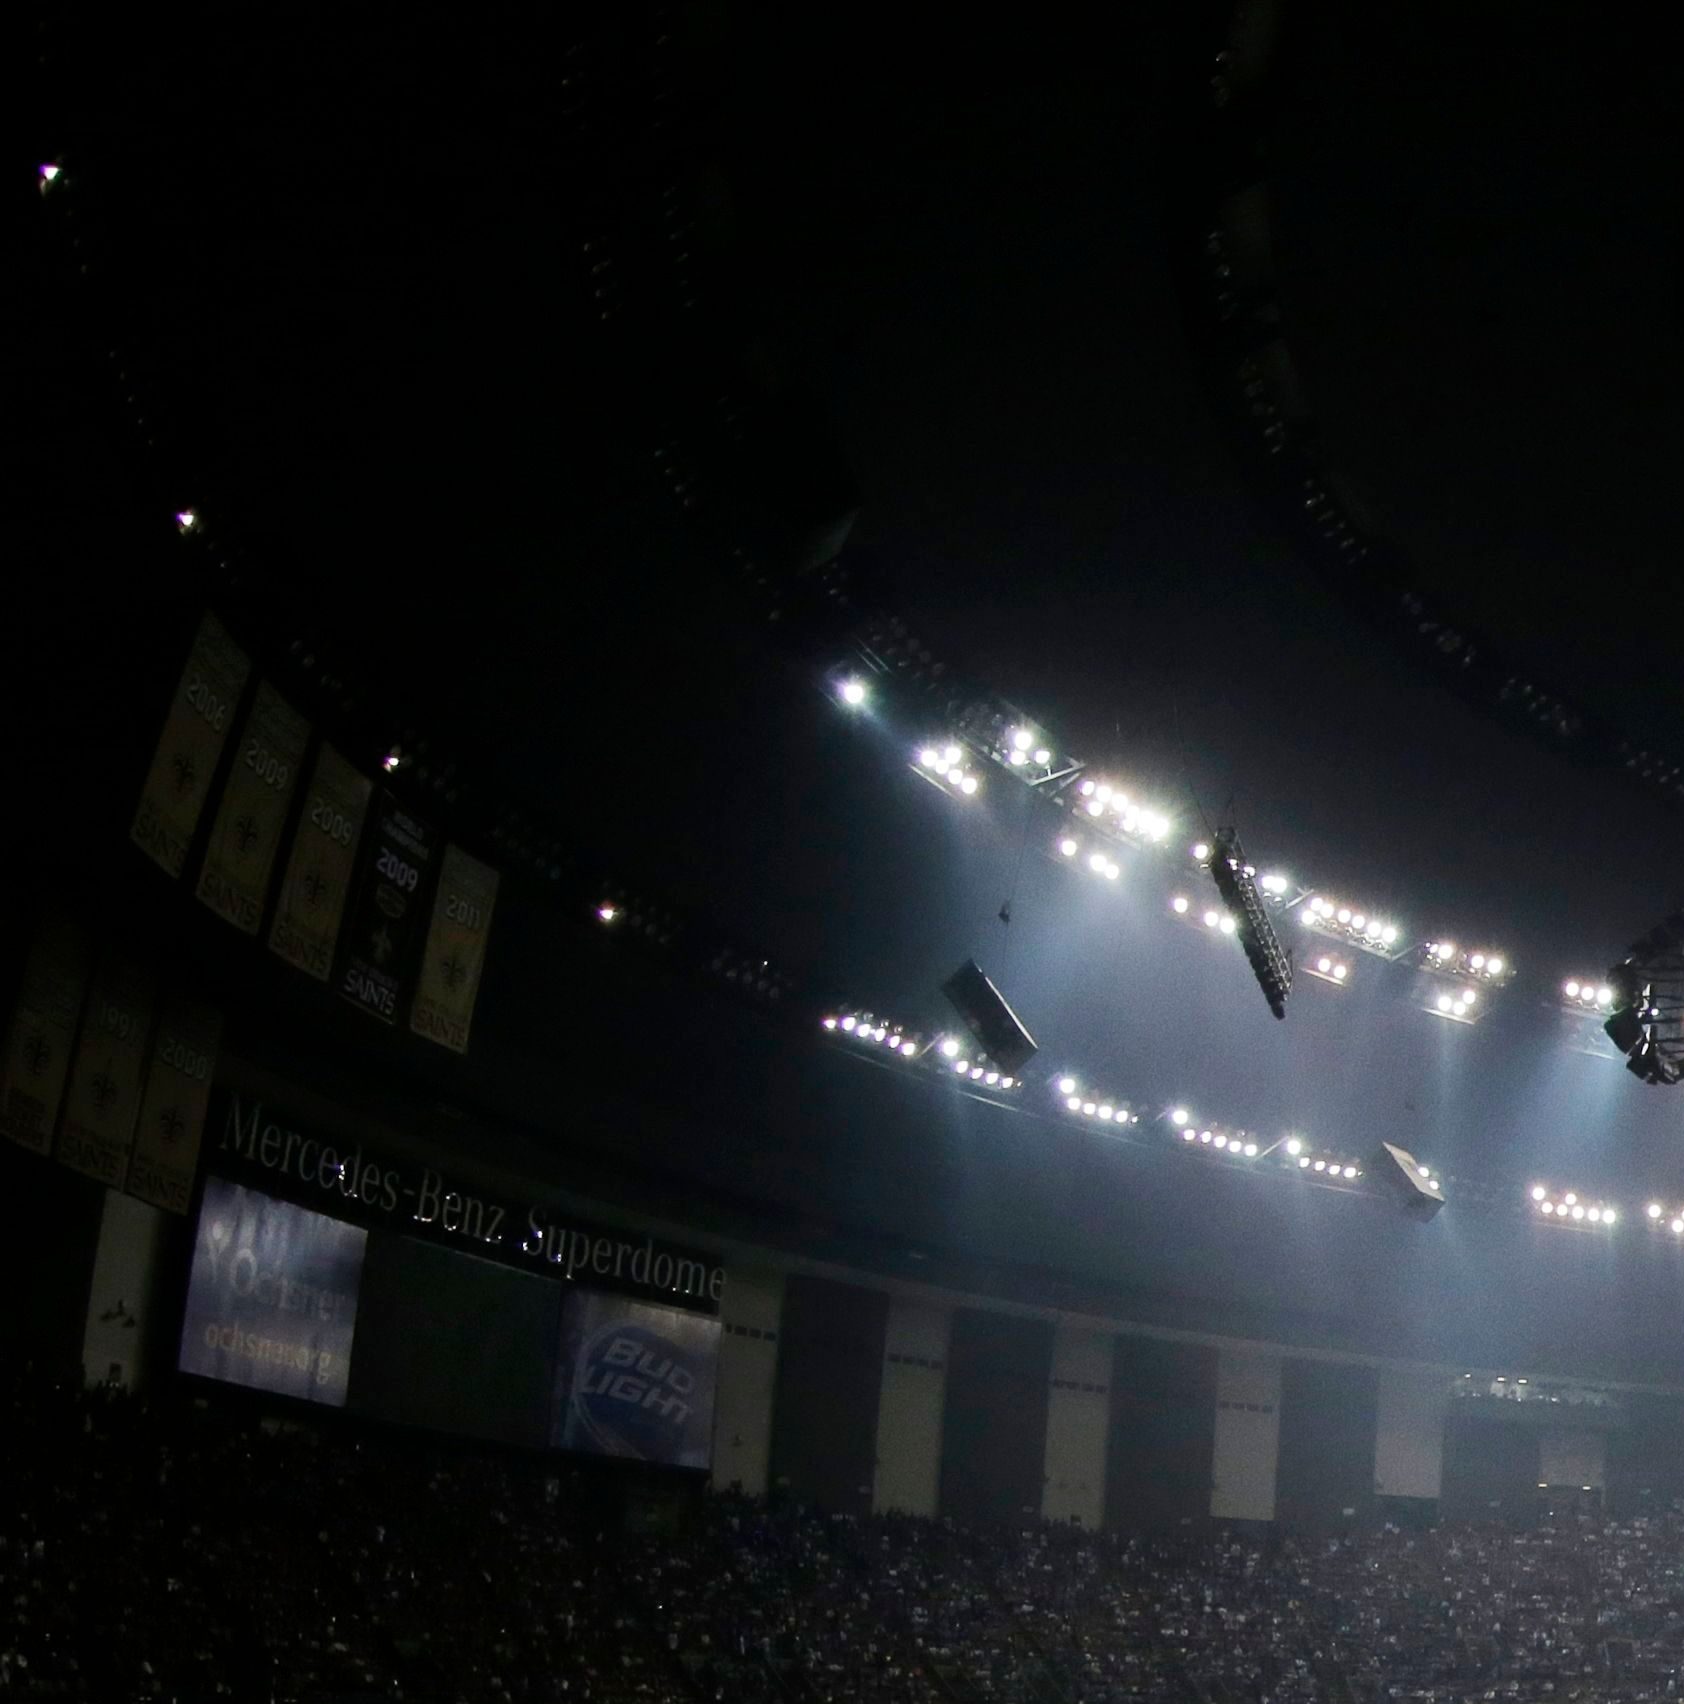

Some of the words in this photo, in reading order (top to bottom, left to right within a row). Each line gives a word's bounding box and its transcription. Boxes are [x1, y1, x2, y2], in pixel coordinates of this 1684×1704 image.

[184, 674, 227, 732] 2006
[245, 739, 289, 790] 2009
[311, 799, 353, 848] 2009
[376, 846, 419, 892] 2009
[445, 894, 479, 926] 2011
[344, 969, 395, 1014] SAINTS
[416, 1009, 465, 1045] SAINTS
[219, 1089, 506, 1243] Mercedes-Benz
[527, 1205, 727, 1300] Superdome
[601, 1337, 695, 1394] BUD
[574, 1366, 695, 1424] LIGHT
